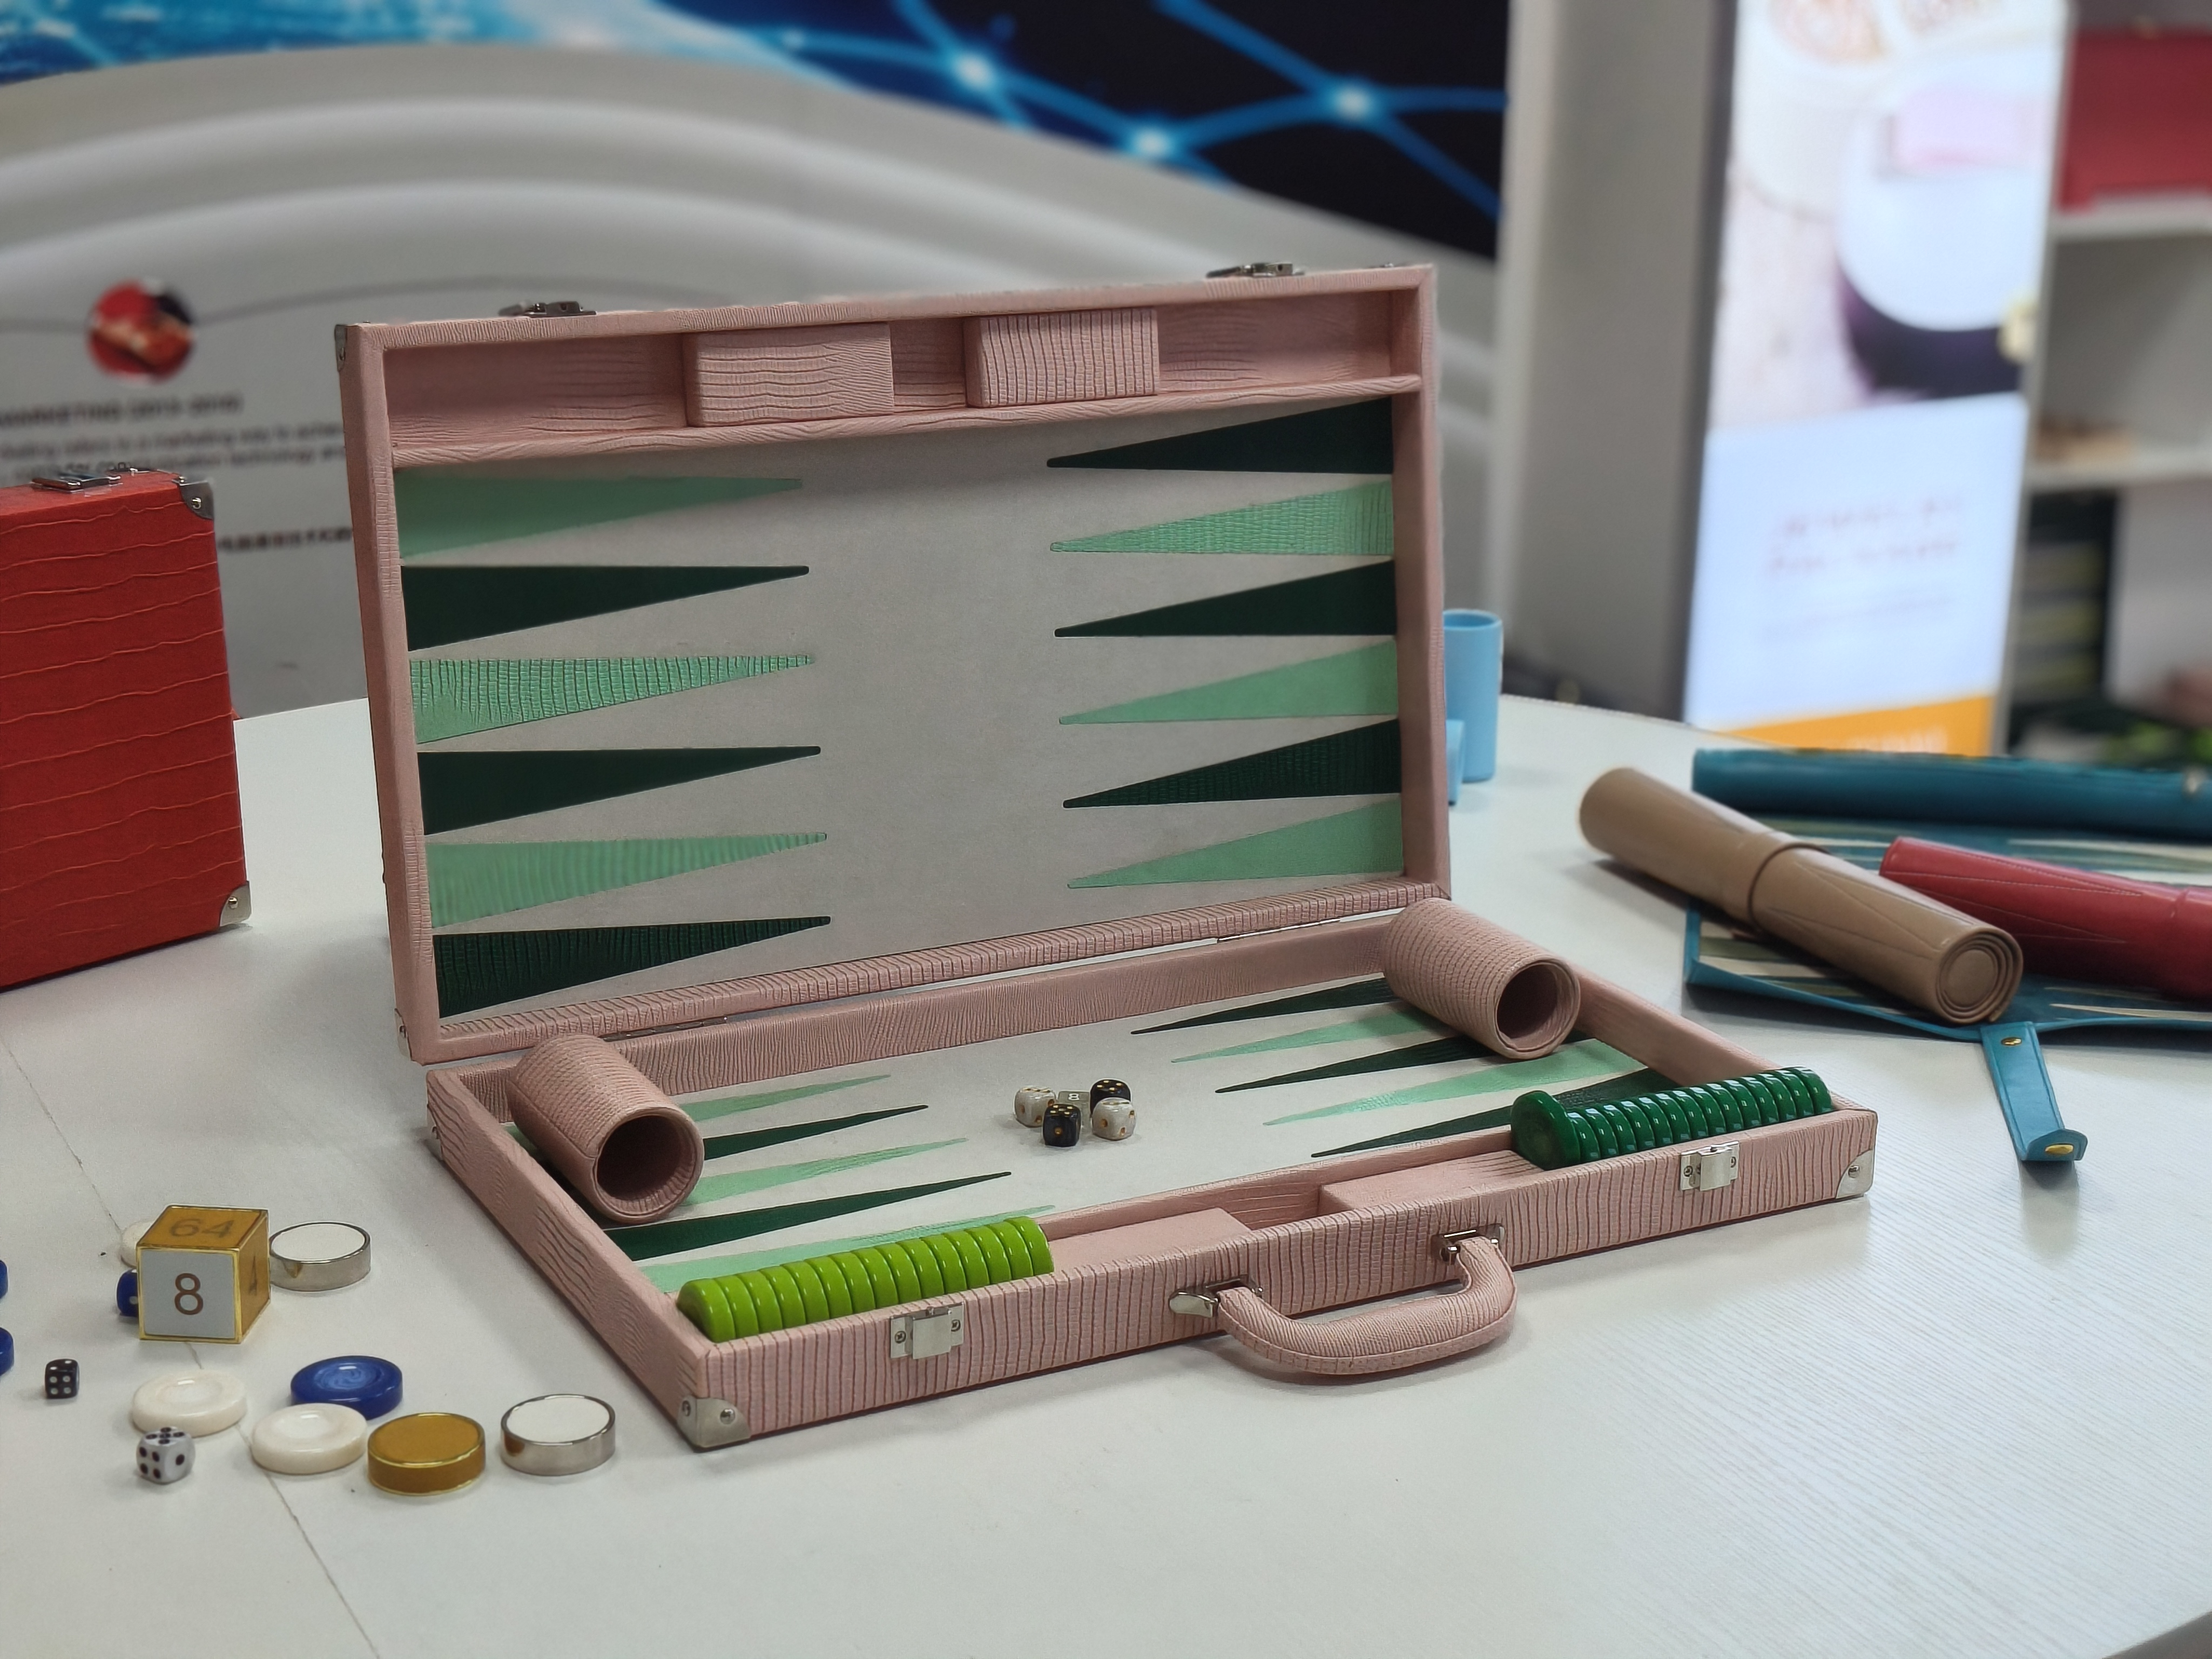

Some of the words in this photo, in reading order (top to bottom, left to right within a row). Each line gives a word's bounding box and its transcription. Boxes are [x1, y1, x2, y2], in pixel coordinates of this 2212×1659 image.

[1068, 1092, 1080, 1101] 8
[170, 1218, 235, 1238] 64
[174, 1273, 204, 1315] 8
